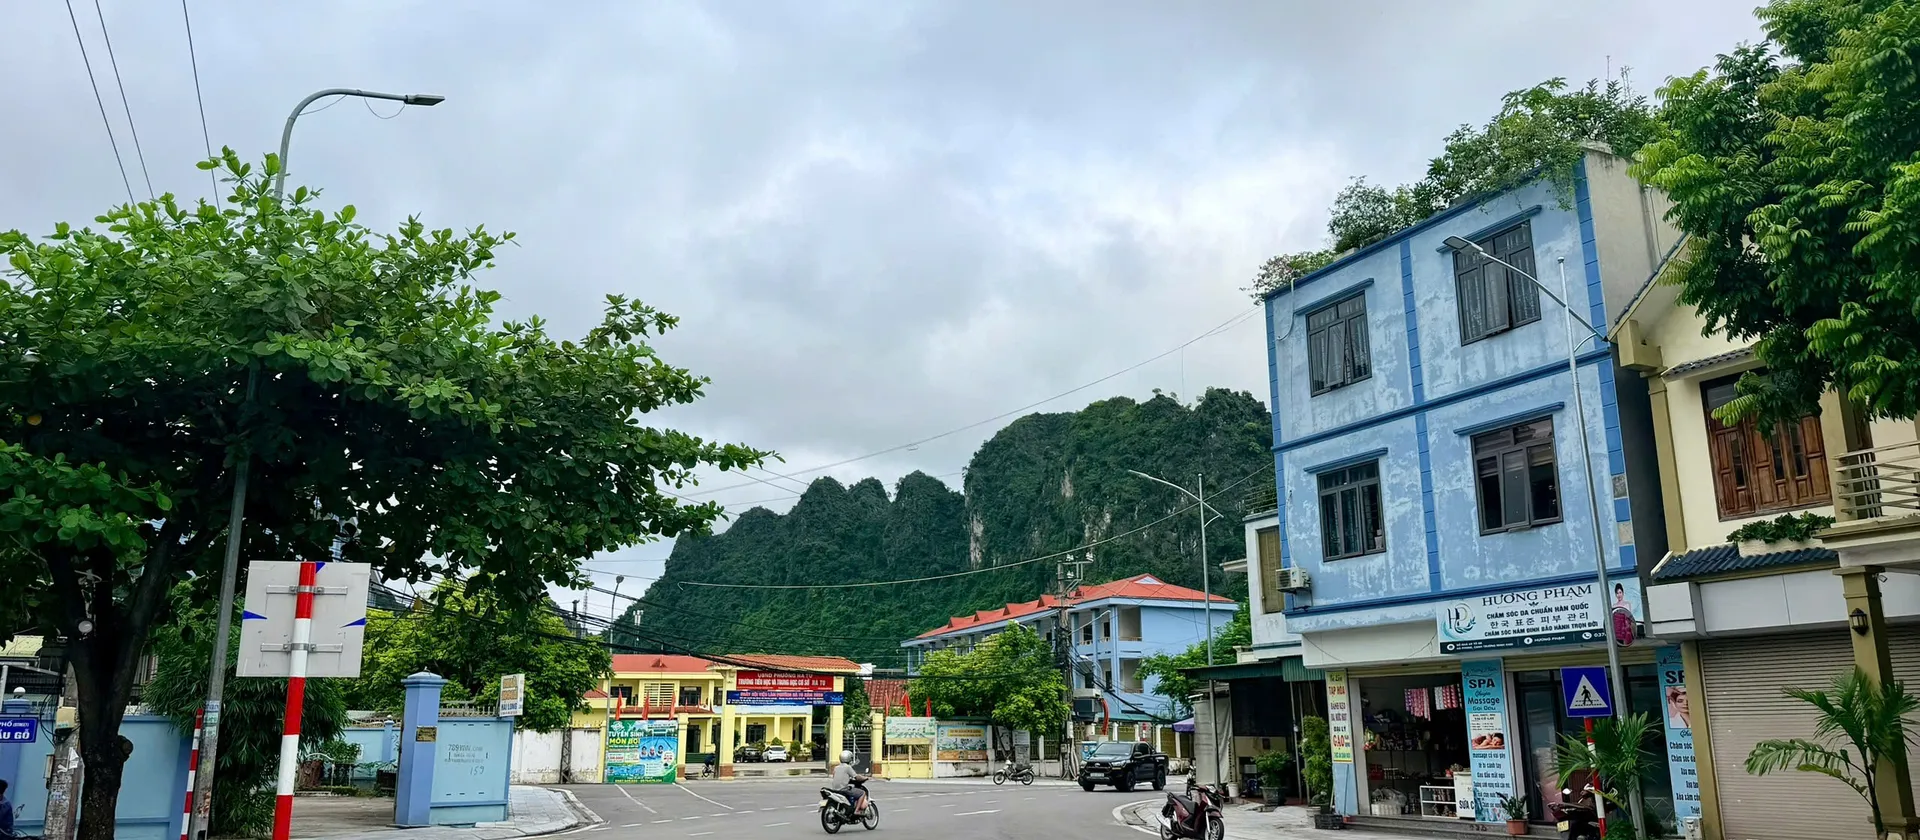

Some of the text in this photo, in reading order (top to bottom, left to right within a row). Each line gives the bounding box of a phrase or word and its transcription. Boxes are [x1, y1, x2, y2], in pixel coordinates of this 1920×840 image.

[1482, 584, 1592, 606] HƯƠNG PHẠM
[1531, 605, 1552, 615] CHUẨN
[1554, 604, 1568, 612] HÀN
[1571, 601, 1589, 611] QUỐC
[1541, 624, 1552, 632] BẢO
[1571, 622, 1586, 630] TRỌN
[1665, 670, 1685, 684] SP
[1468, 678, 1495, 689] SPA
[1468, 697, 1500, 705] Massage
[470, 765, 484, 776] 159
